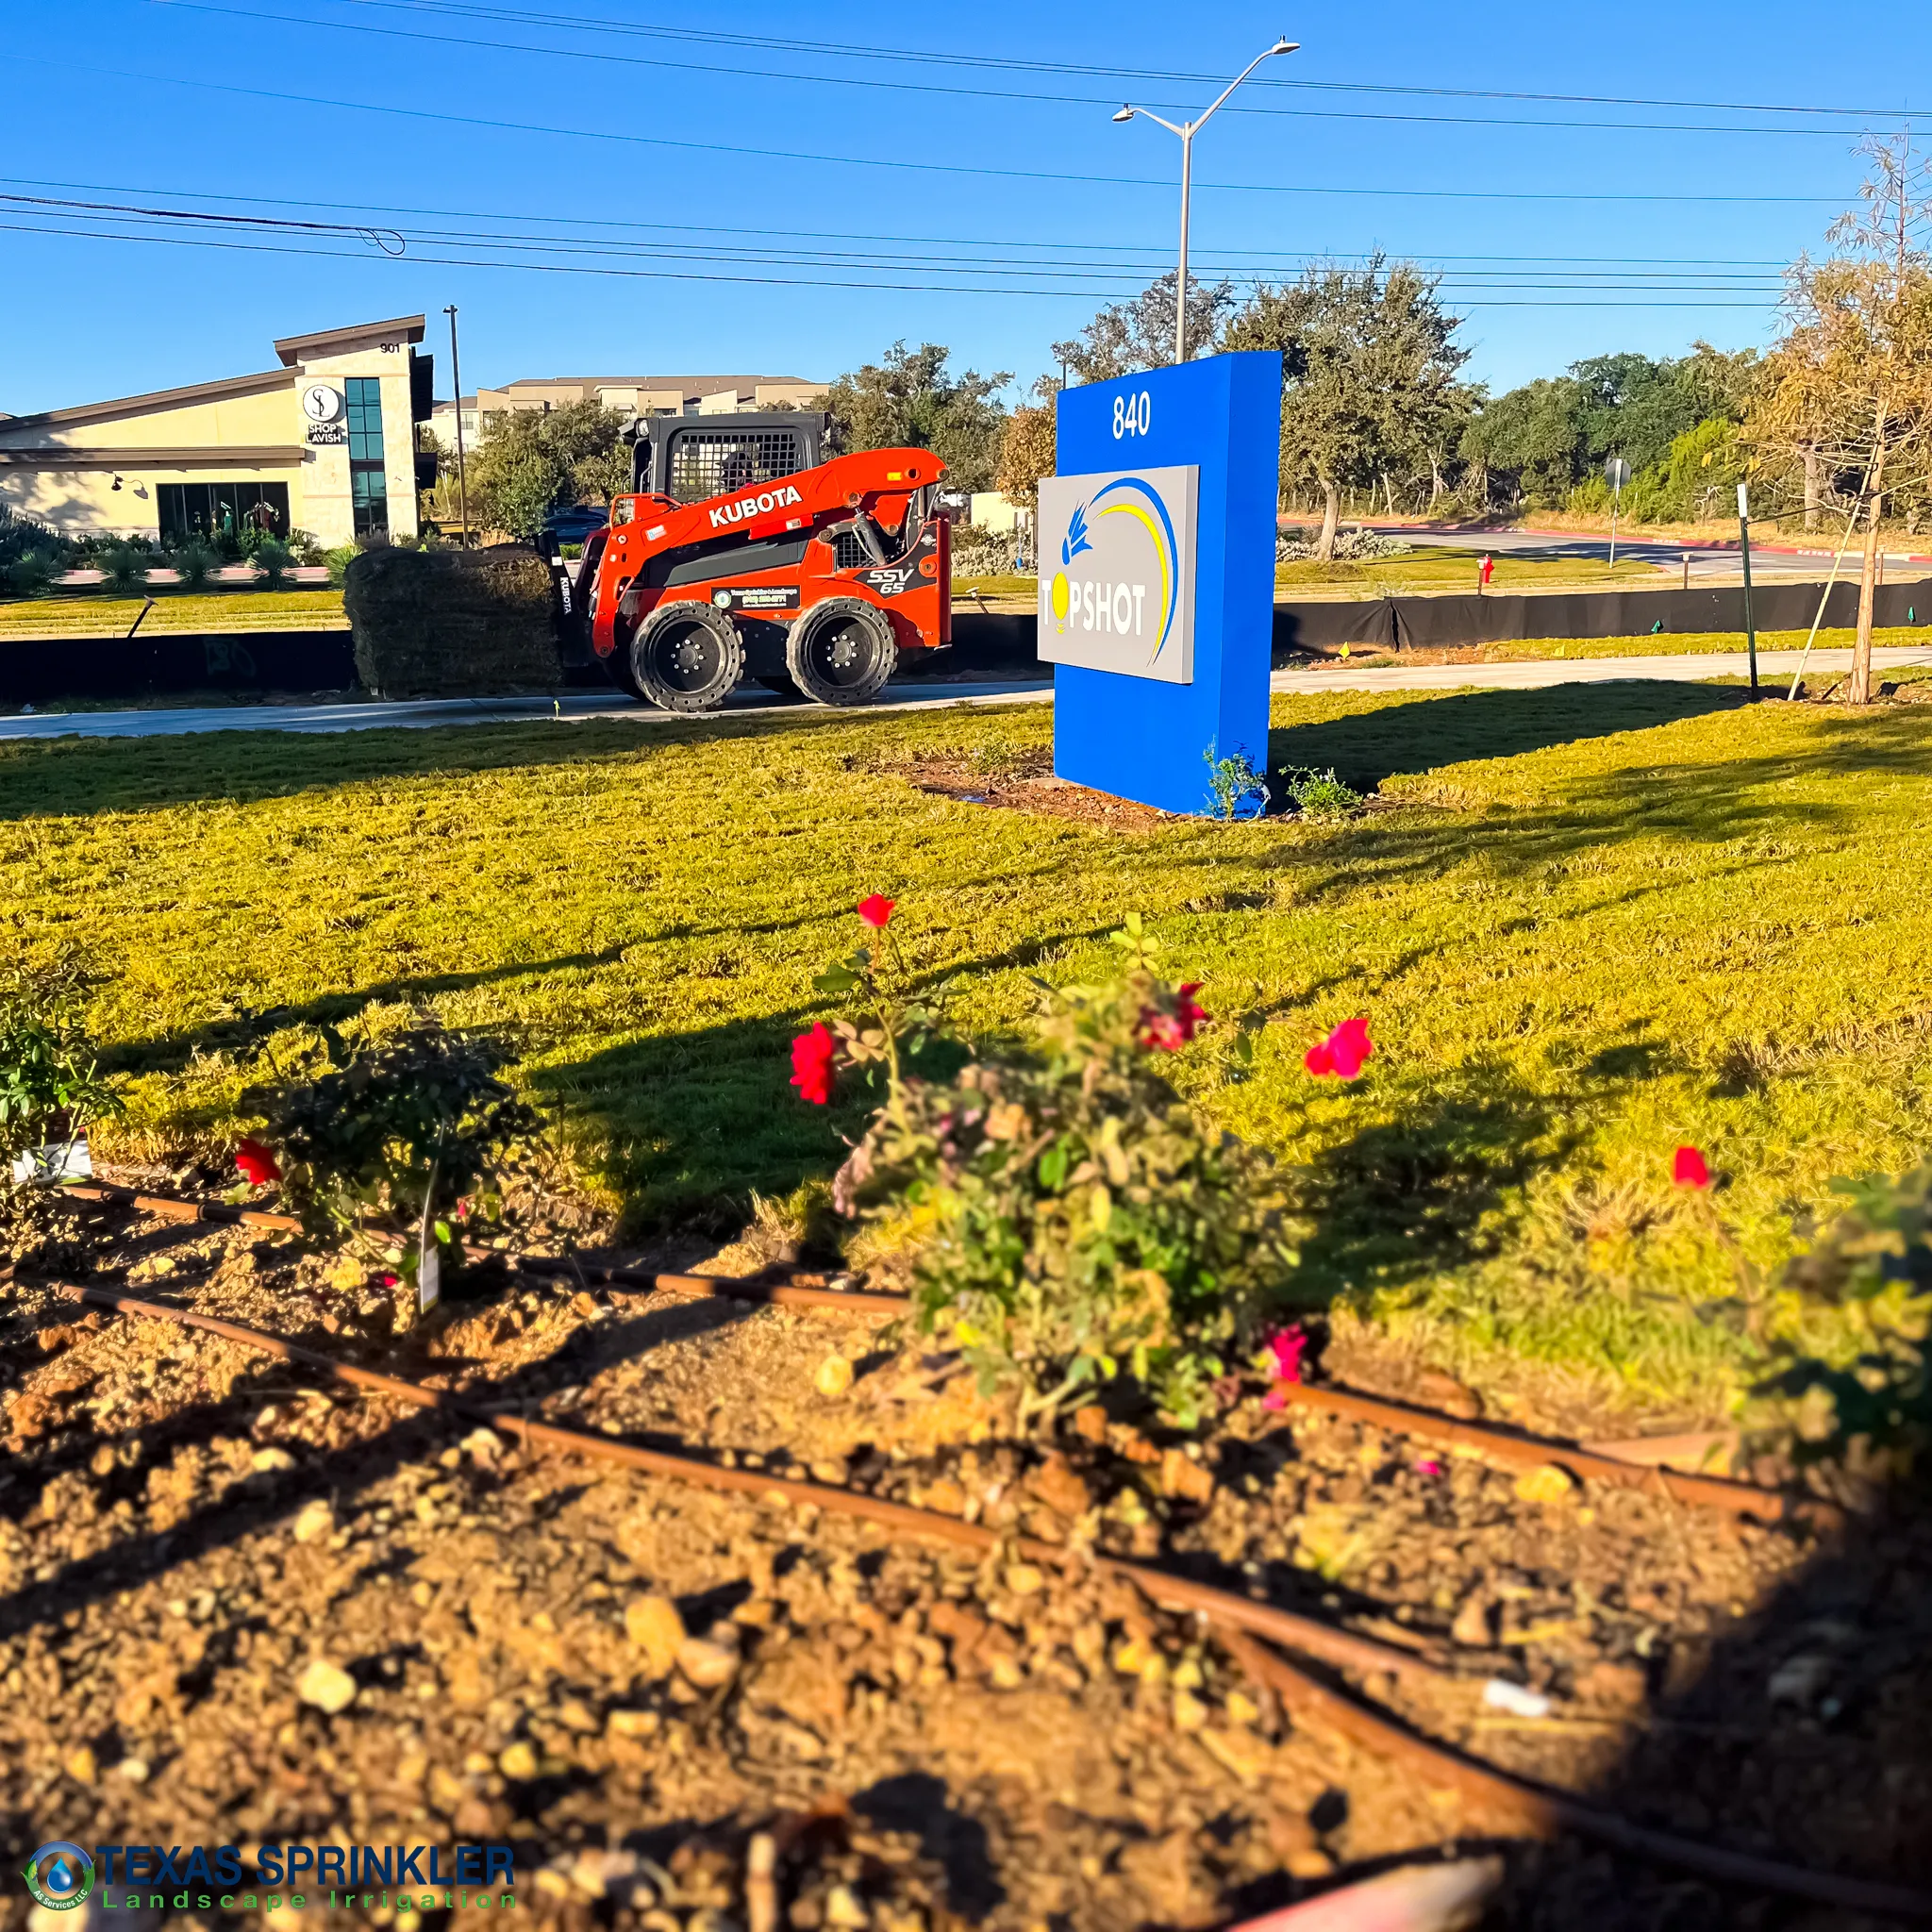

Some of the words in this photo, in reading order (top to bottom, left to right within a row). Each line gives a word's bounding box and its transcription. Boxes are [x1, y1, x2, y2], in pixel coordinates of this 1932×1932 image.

[380, 343, 400, 353] 901
[1112, 391, 1151, 440] 840
[308, 424, 337, 433] SHOP
[306, 434, 341, 442] LAVISH
[708, 485, 803, 528] KUBOTA
[867, 568, 914, 583] SSV
[880, 582, 906, 593] 65
[559, 576, 572, 615] KUBOTA
[1041, 572, 1146, 636] TOPSHOT
